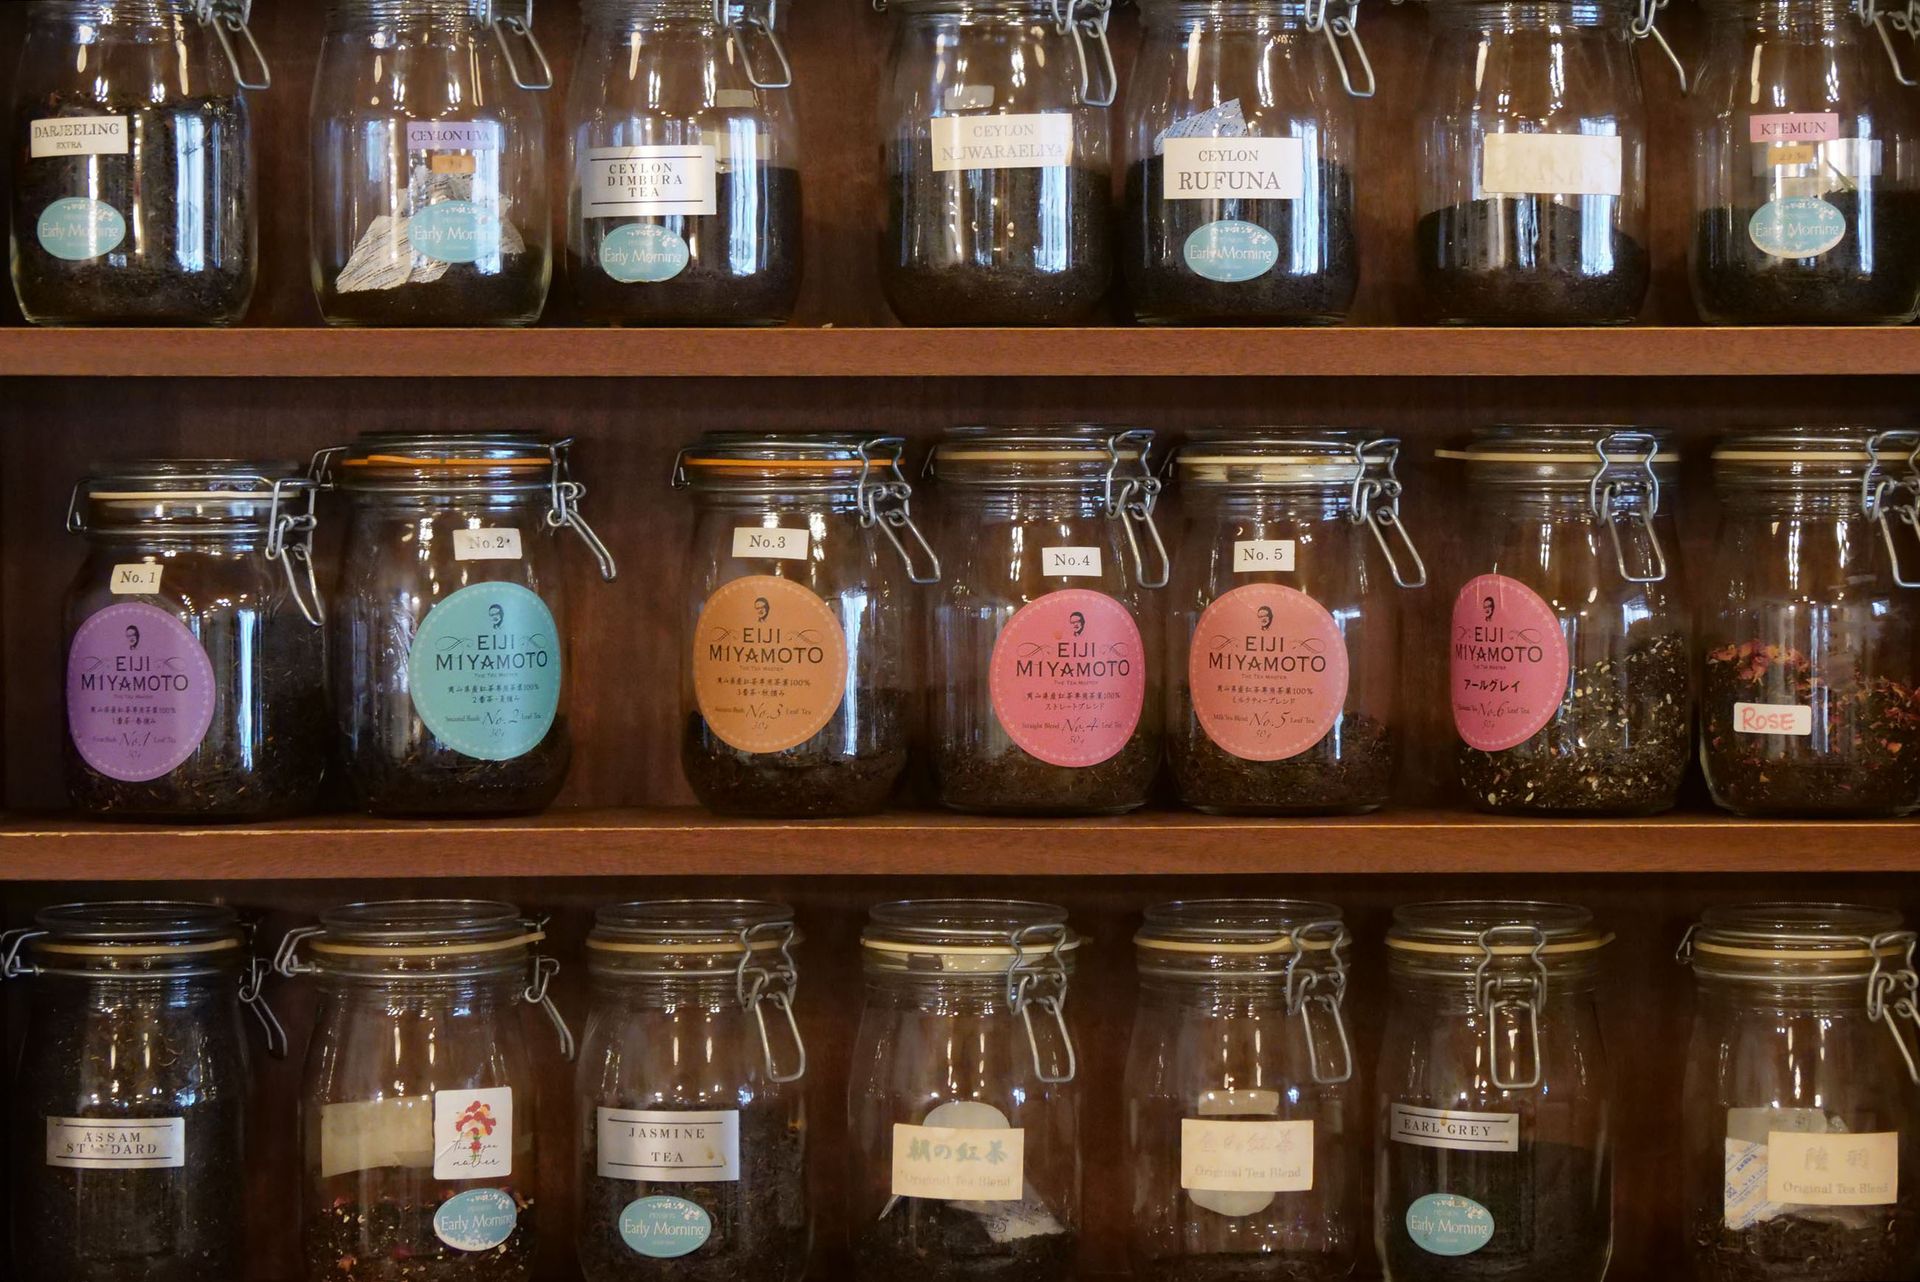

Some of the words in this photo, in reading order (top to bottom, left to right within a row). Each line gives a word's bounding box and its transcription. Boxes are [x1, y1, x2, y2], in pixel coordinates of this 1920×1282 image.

[34, 123, 120, 138] DARJEELING
[411, 130, 462, 141] CEYLON
[465, 130, 491, 141] UVA
[973, 123, 1034, 137] CEYLON
[56, 141, 83, 150] EXTRA
[1198, 150, 1260, 162] CEYLON
[609, 162, 673, 175] CEYLON
[608, 175, 683, 187] DIMBURA
[1179, 171, 1282, 190] RUFUNA
[628, 187, 660, 198] TEA
[415, 226, 442, 243] Early
[447, 226, 495, 243] Mornin
[1788, 223, 1839, 237] Morning
[605, 248, 629, 266] Early
[632, 249, 683, 266] Morning
[1220, 246, 1272, 263] Morning
[750, 535, 786, 548] No.3
[1055, 554, 1091, 566] No.4
[743, 628, 780, 643] EIJI
[1475, 627, 1503, 642] EIJI
[478, 635, 514, 650] EIJI
[1058, 642, 1095, 658] EIJI
[1246, 636, 1284, 652] EIJI
[436, 651, 548, 671] MIYAMOTO
[709, 644, 824, 664] MIYAMOTO
[1455, 645, 1543, 663] MIYAMOTO
[116, 656, 150, 672] EIJI
[1016, 659, 1130, 677] MIYAMOTO
[1209, 652, 1327, 673] MIYAMOTO
[81, 674, 189, 691] MIYAMOTO
[1464, 679, 1520, 693] アールグレイ
[629, 1127, 705, 1140] JASMINE
[1404, 1119, 1440, 1133] EARL
[1447, 1124, 1491, 1137] GREY
[84, 1132, 141, 1143] ASSAM
[651, 1151, 685, 1163] TEA
[1194, 1164, 1242, 1178] Original
[1244, 1167, 1265, 1178] Tea
[1270, 1166, 1301, 1178] Blend
[1783, 1180, 1832, 1194] Original
[1837, 1183, 1856, 1194] Tea
[1860, 1182, 1889, 1193] Blend
[441, 1217, 467, 1235] Early
[472, 1212, 514, 1231] Morning
[625, 1218, 650, 1238] Early
[654, 1220, 704, 1239] Morning
[1411, 1215, 1435, 1236] Early
[1437, 1218, 1488, 1239] Morning
